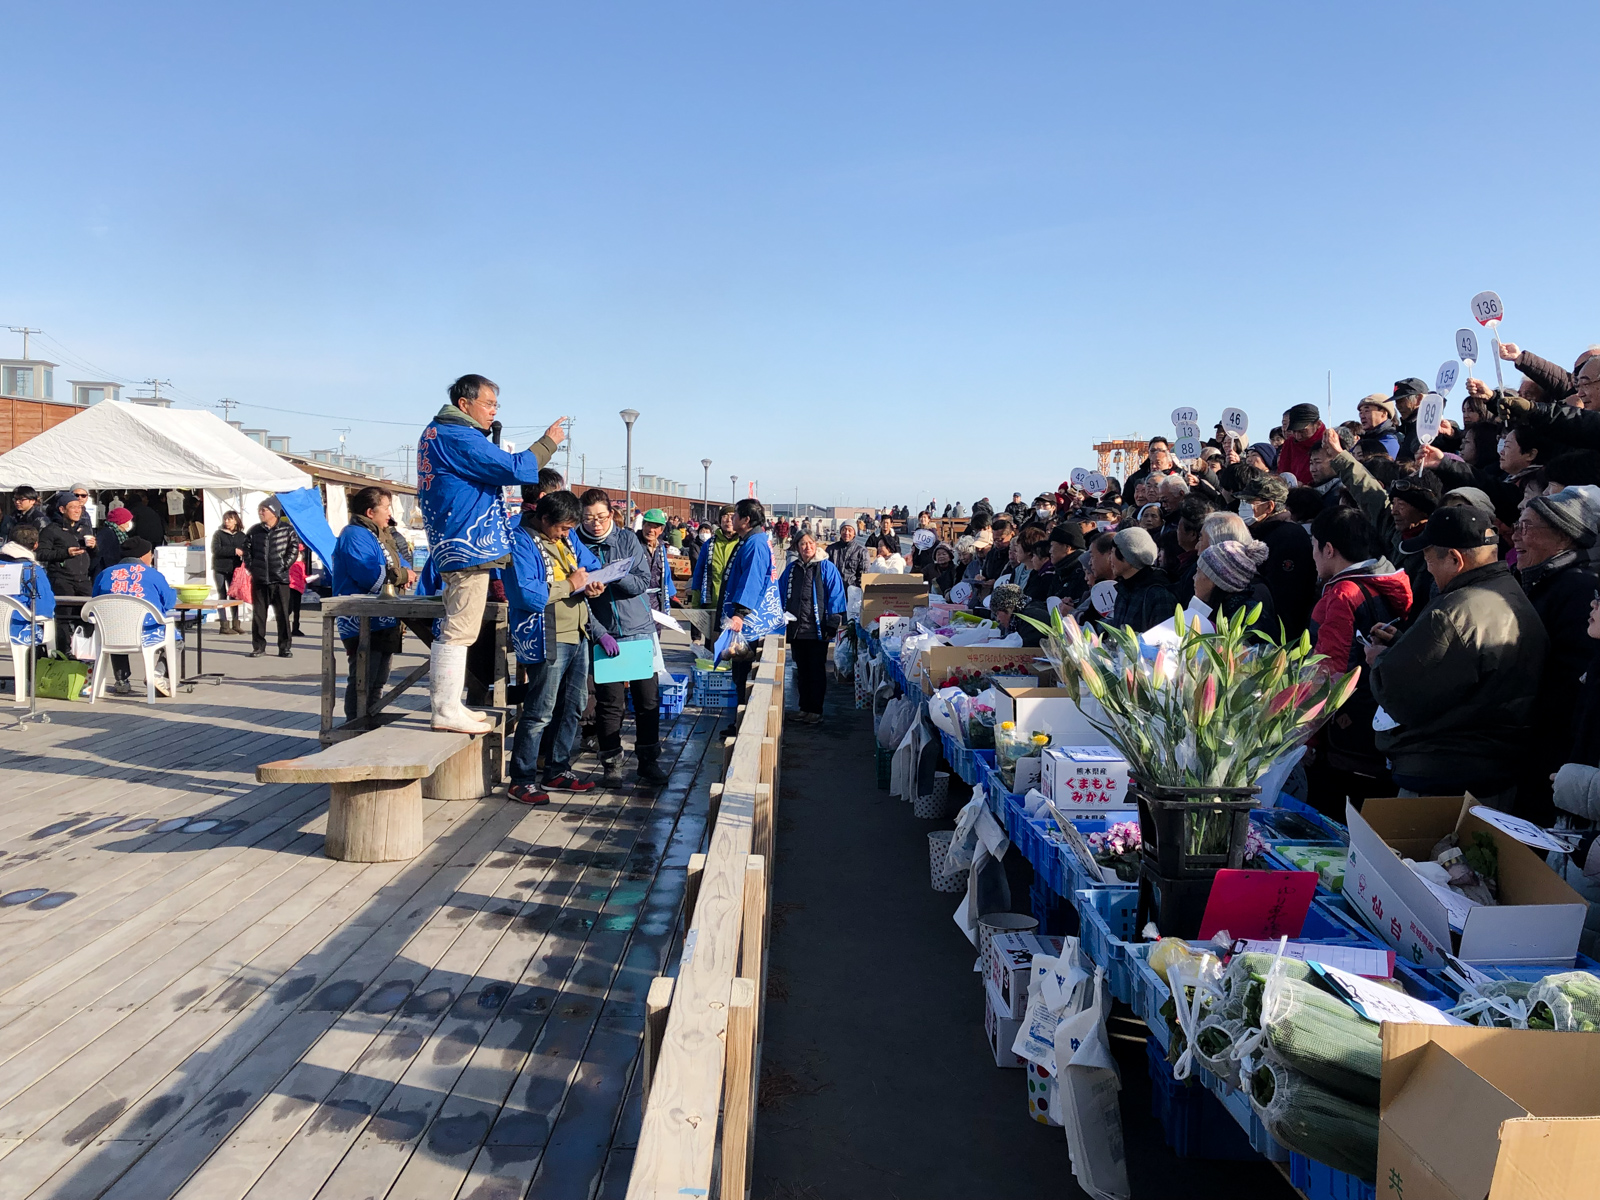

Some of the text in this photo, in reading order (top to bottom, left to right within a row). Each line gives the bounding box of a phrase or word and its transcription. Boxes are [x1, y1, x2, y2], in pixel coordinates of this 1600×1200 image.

[1476, 299, 1498, 316] 136
[1461, 337, 1473, 353] 43
[1440, 368, 1456, 384] 154
[1176, 411, 1194, 421] 147
[1229, 412, 1241, 426] 46
[1424, 403, 1437, 424] 89
[1182, 426, 1194, 438] 13
[1181, 442, 1195, 455] 88
[1075, 472, 1086, 482] 42
[1089, 479, 1100, 490] 91
[917, 533, 932, 544] 105
[110, 567, 130, 594] 港朝
[955, 588, 966, 599] 51
[1099, 590, 1115, 606] 11
[1076, 767, 1108, 776] 熊本県産
[1065, 778, 1117, 790] くまもと
[1071, 791, 1112, 803] みかん
